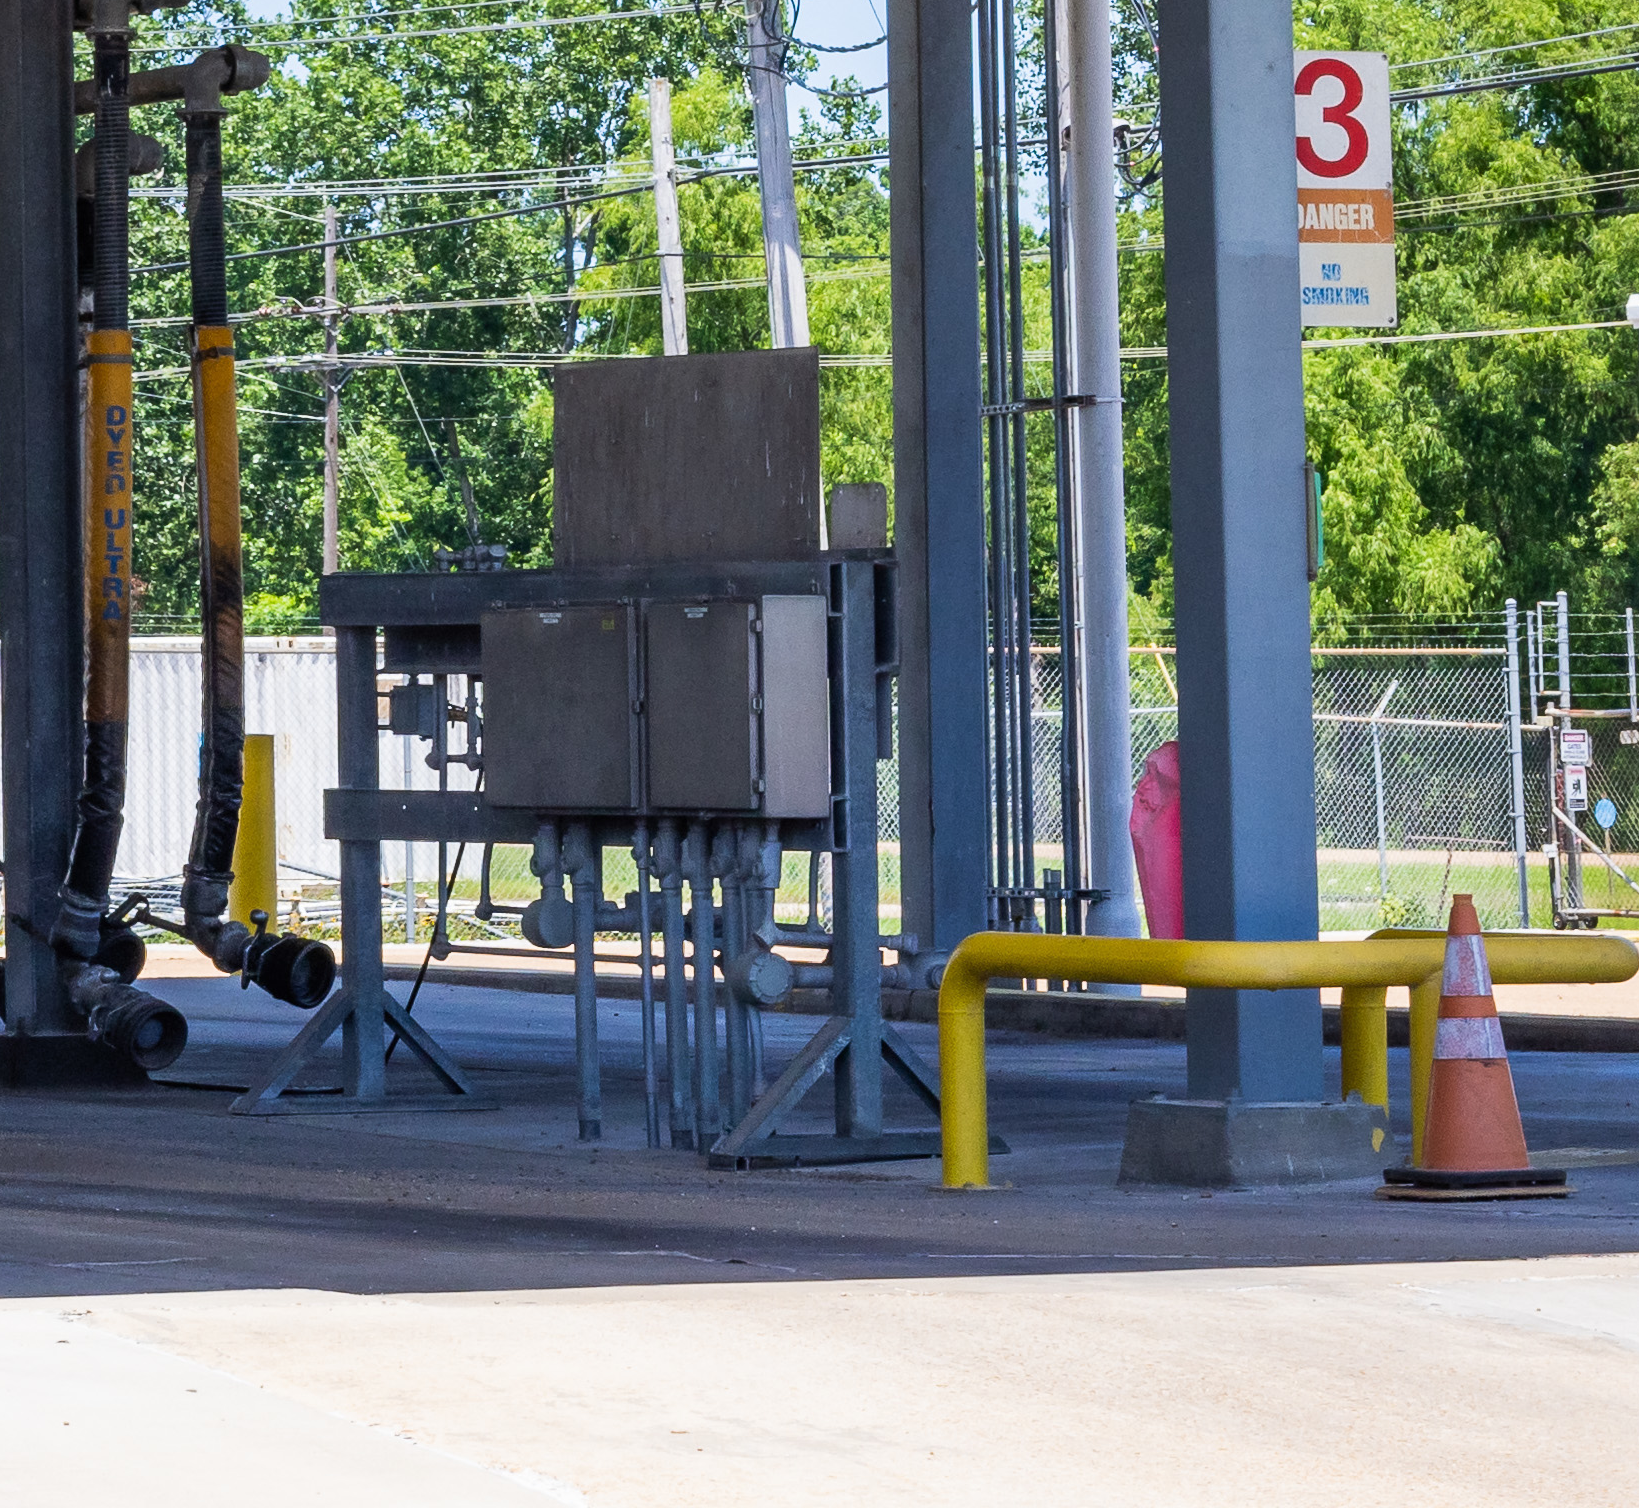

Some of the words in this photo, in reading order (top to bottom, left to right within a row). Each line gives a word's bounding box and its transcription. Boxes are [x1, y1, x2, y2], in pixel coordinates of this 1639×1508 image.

[1294, 58, 1368, 178] 3
[1302, 287, 1370, 305] SMOKING
[1321, 264, 1341, 281] NO
[102, 508, 126, 620] ULTRA
